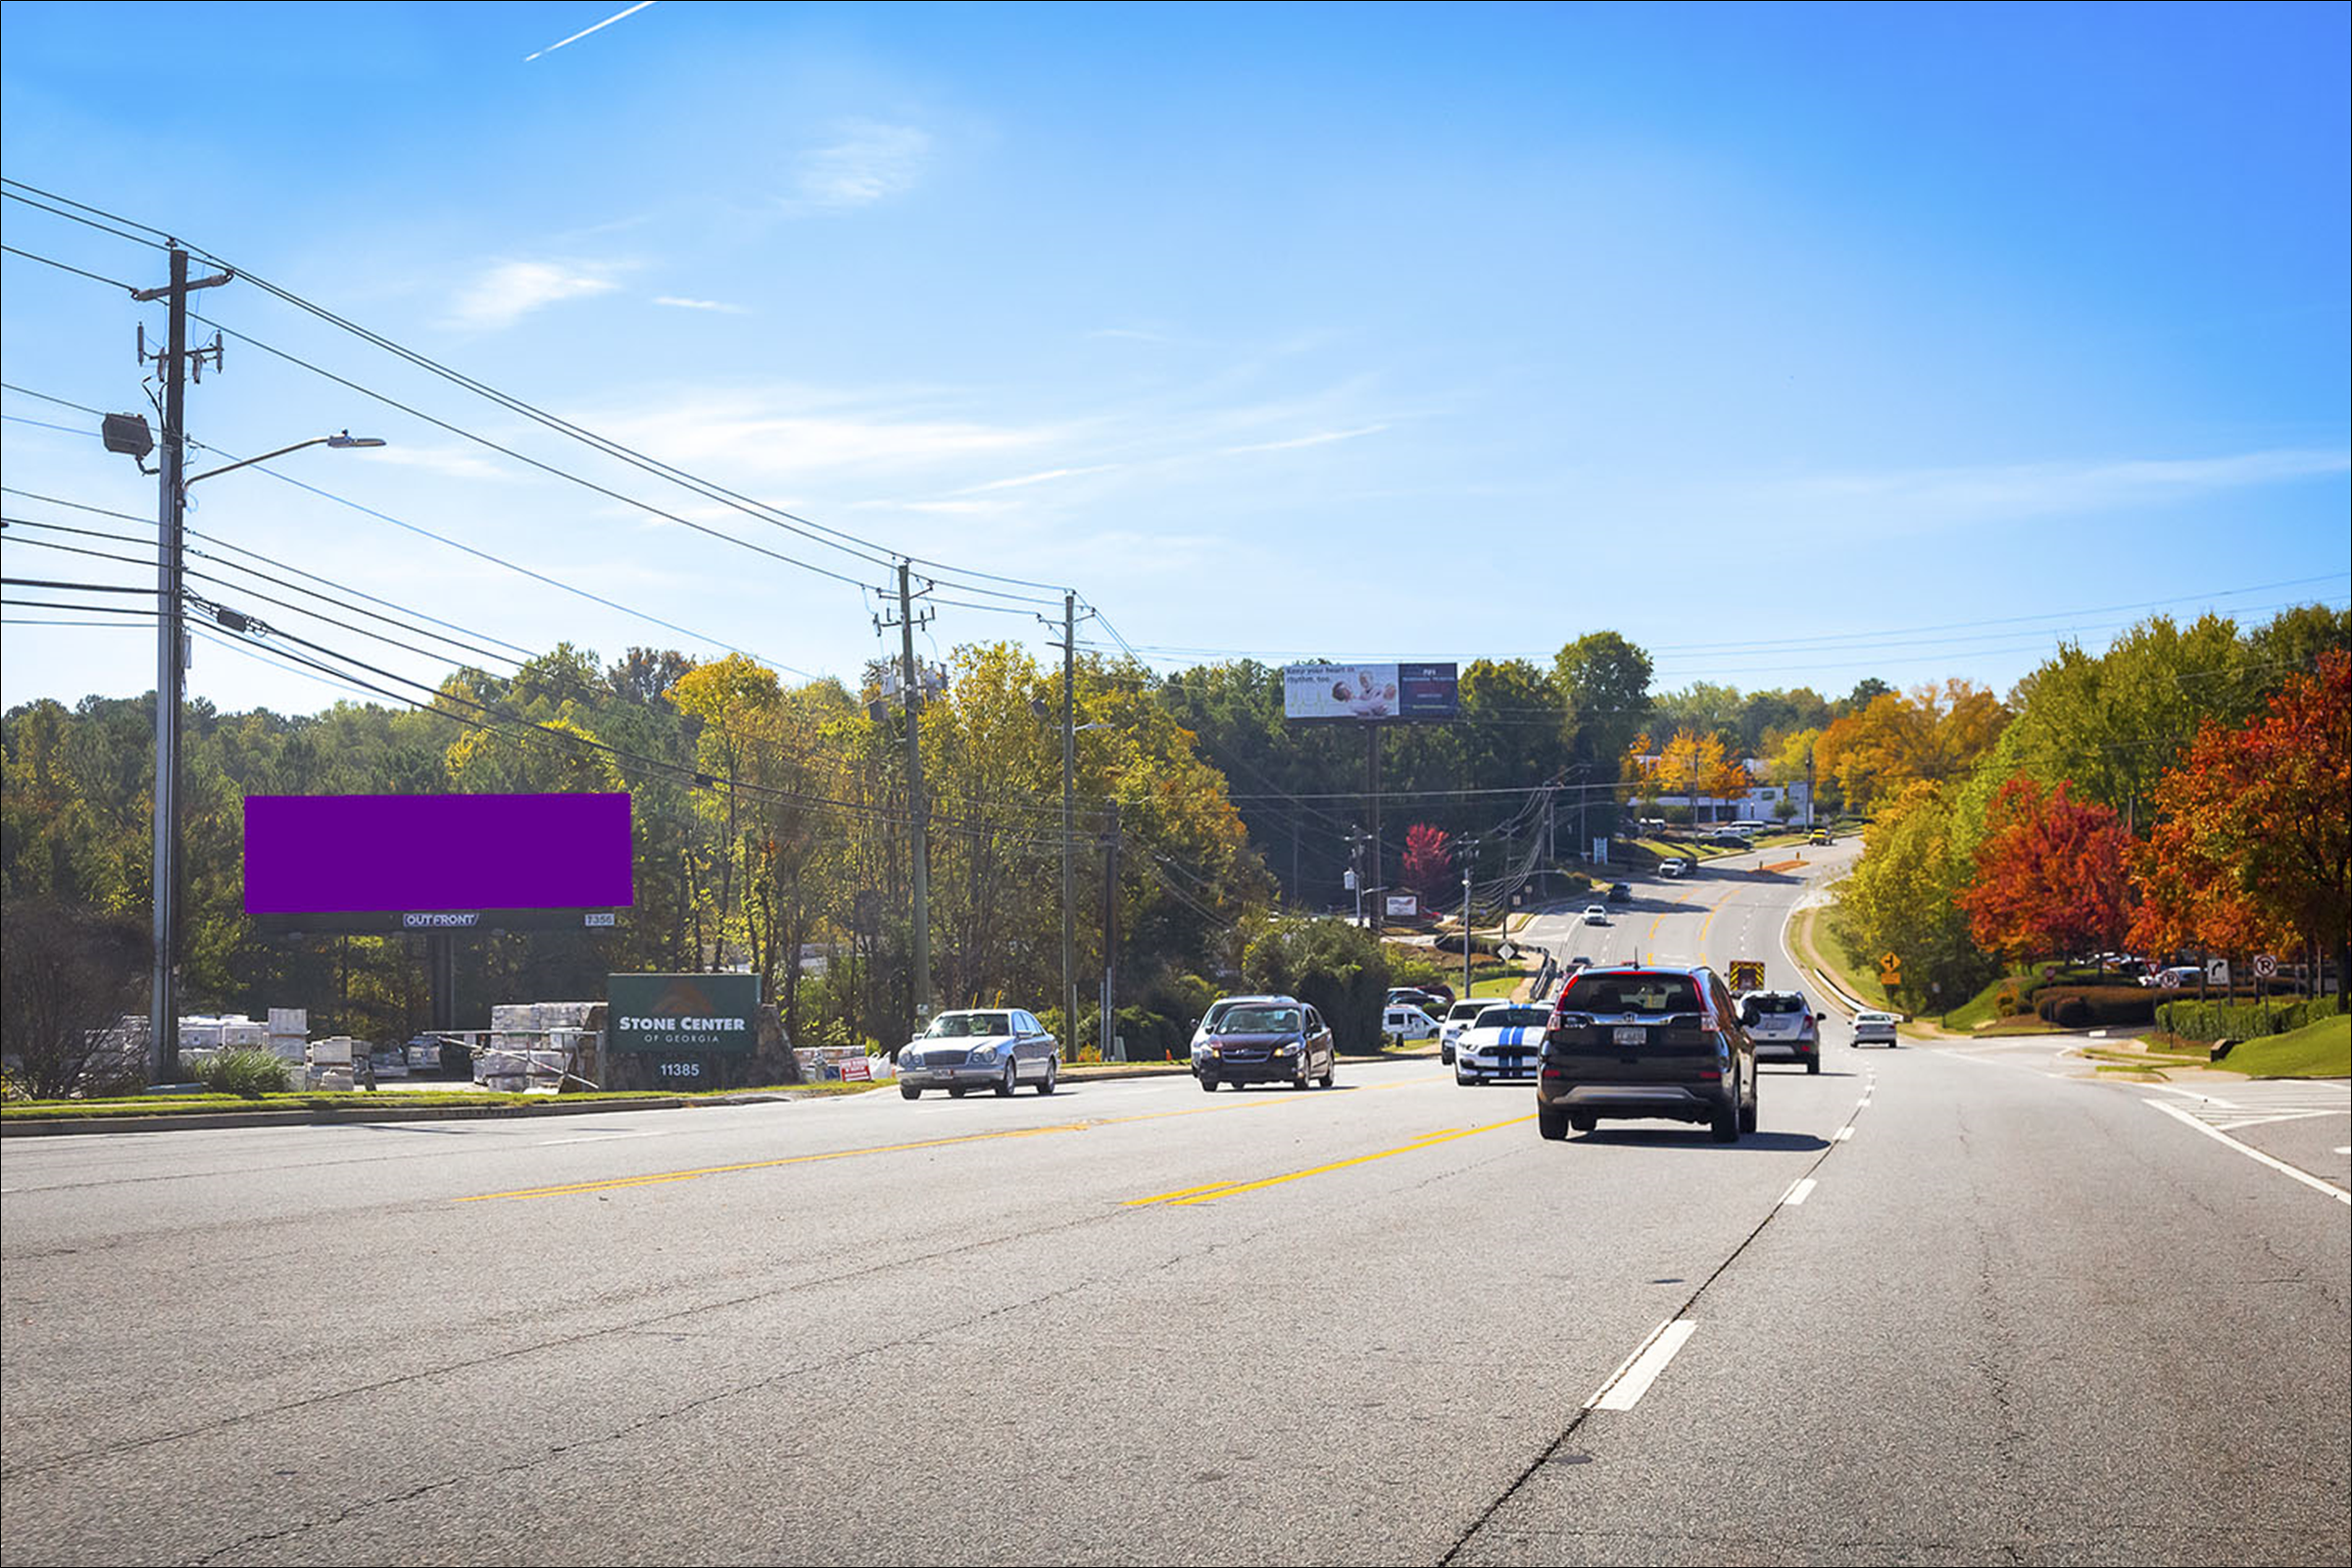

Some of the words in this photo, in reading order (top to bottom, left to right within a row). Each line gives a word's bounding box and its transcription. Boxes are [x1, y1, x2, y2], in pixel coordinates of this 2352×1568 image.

[619, 1017, 676, 1030] STONE
[681, 1017, 745, 1030] CENTER
[644, 1034, 659, 1043] OF
[665, 1034, 719, 1043] GEORGIA
[661, 1063, 700, 1077] 11385
